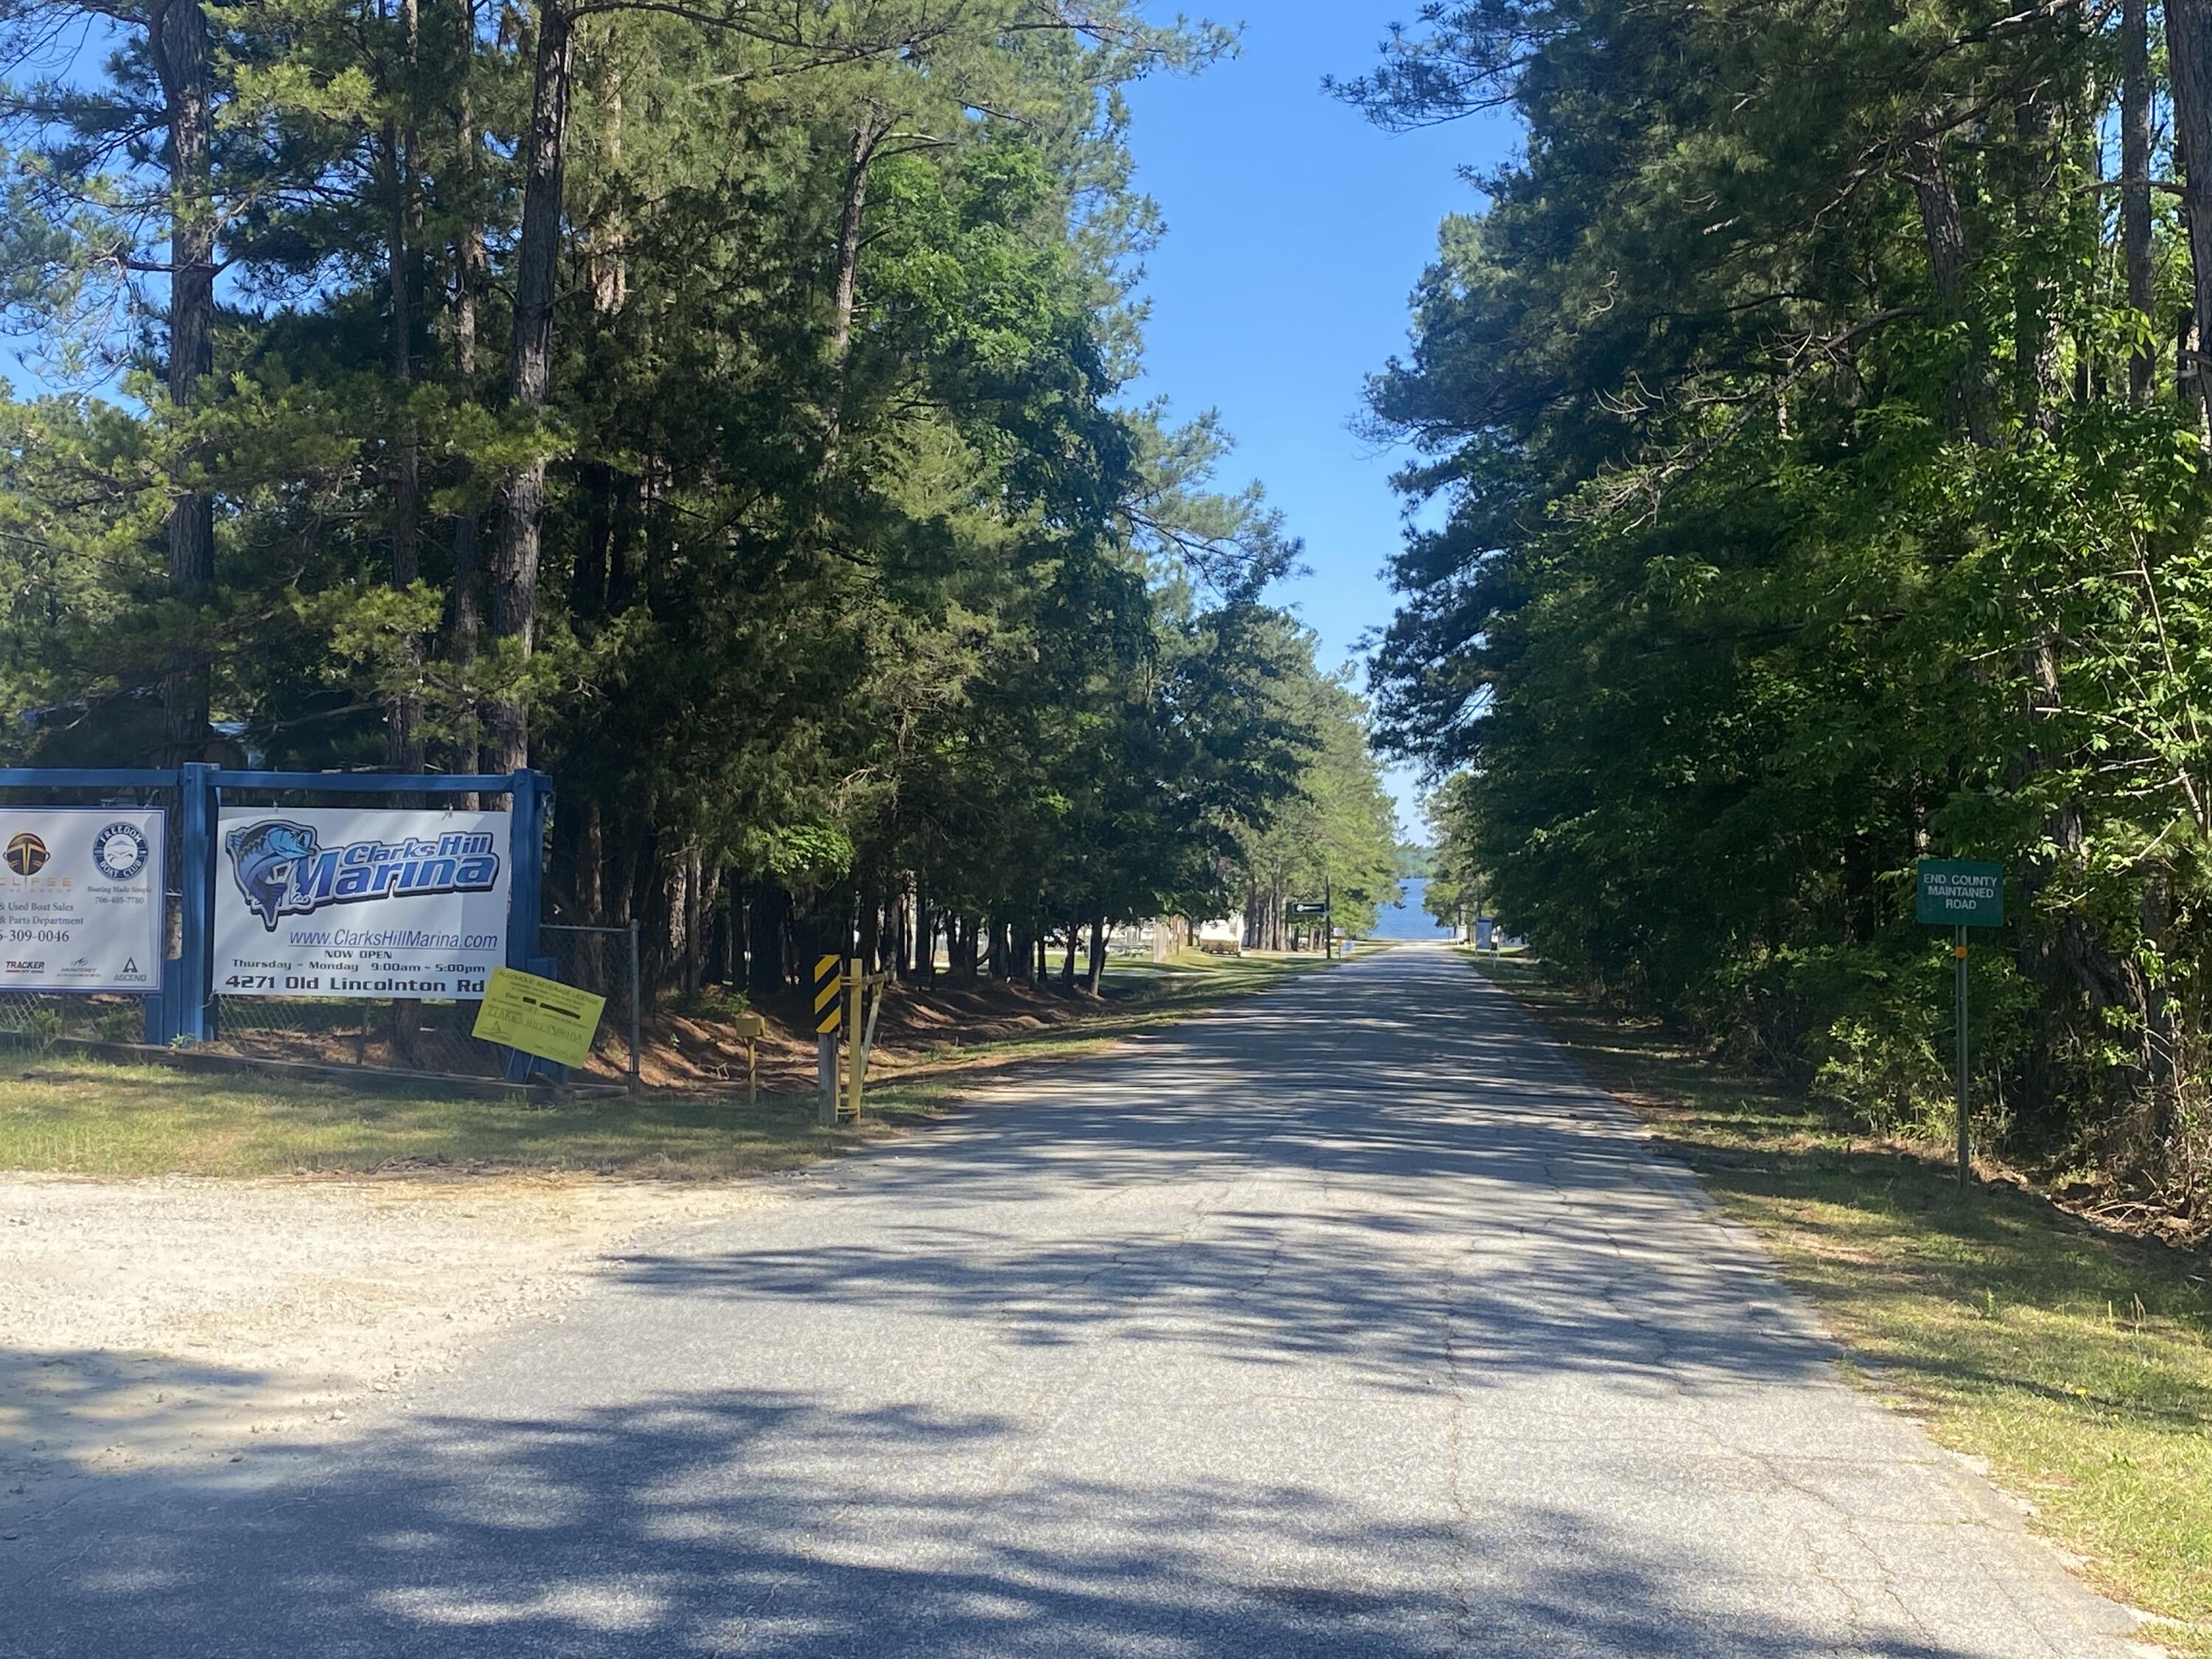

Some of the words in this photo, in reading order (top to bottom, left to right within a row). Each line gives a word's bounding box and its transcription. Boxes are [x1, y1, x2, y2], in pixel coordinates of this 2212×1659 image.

[100, 825, 142, 843] FREEDOM
[344, 839, 436, 866] Clarks
[439, 835, 490, 857] Hill
[100, 860, 119, 877] BOAT
[123, 860, 142, 877] CLUB
[288, 850, 498, 902] Marina
[1923, 873, 1947, 884] END
[1952, 874, 1997, 887] COUNTY
[87, 886, 111, 894] Boating
[1928, 886, 1994, 898] MAINTAINED
[8, 902, 29, 911] Used
[31, 902, 50, 911] Boat
[52, 902, 74, 911] Sales
[1945, 899, 1977, 909] ROAD
[9, 916, 30, 925] Parts
[32, 917, 83, 927] Department
[290, 929, 498, 948] www.ClarksHillMarina.com
[324, 950, 355, 959] NOW
[359, 950, 393, 959] OPEN
[6, 961, 45, 970] TRACKER
[232, 959, 292, 970] Thursday
[309, 961, 358, 973] Monday
[371, 963, 421, 972] 9:00am
[434, 964, 485, 974] 5:00pm
[114, 974, 147, 982] ASCEND
[226, 975, 275, 989] 4271
[285, 977, 319, 990] Old
[330, 978, 446, 992] Lincolnton
[457, 979, 485, 992] Rd
[498, 970, 535, 985] ALCOHOLIC
[537, 979, 571, 996] BEVERAGE
